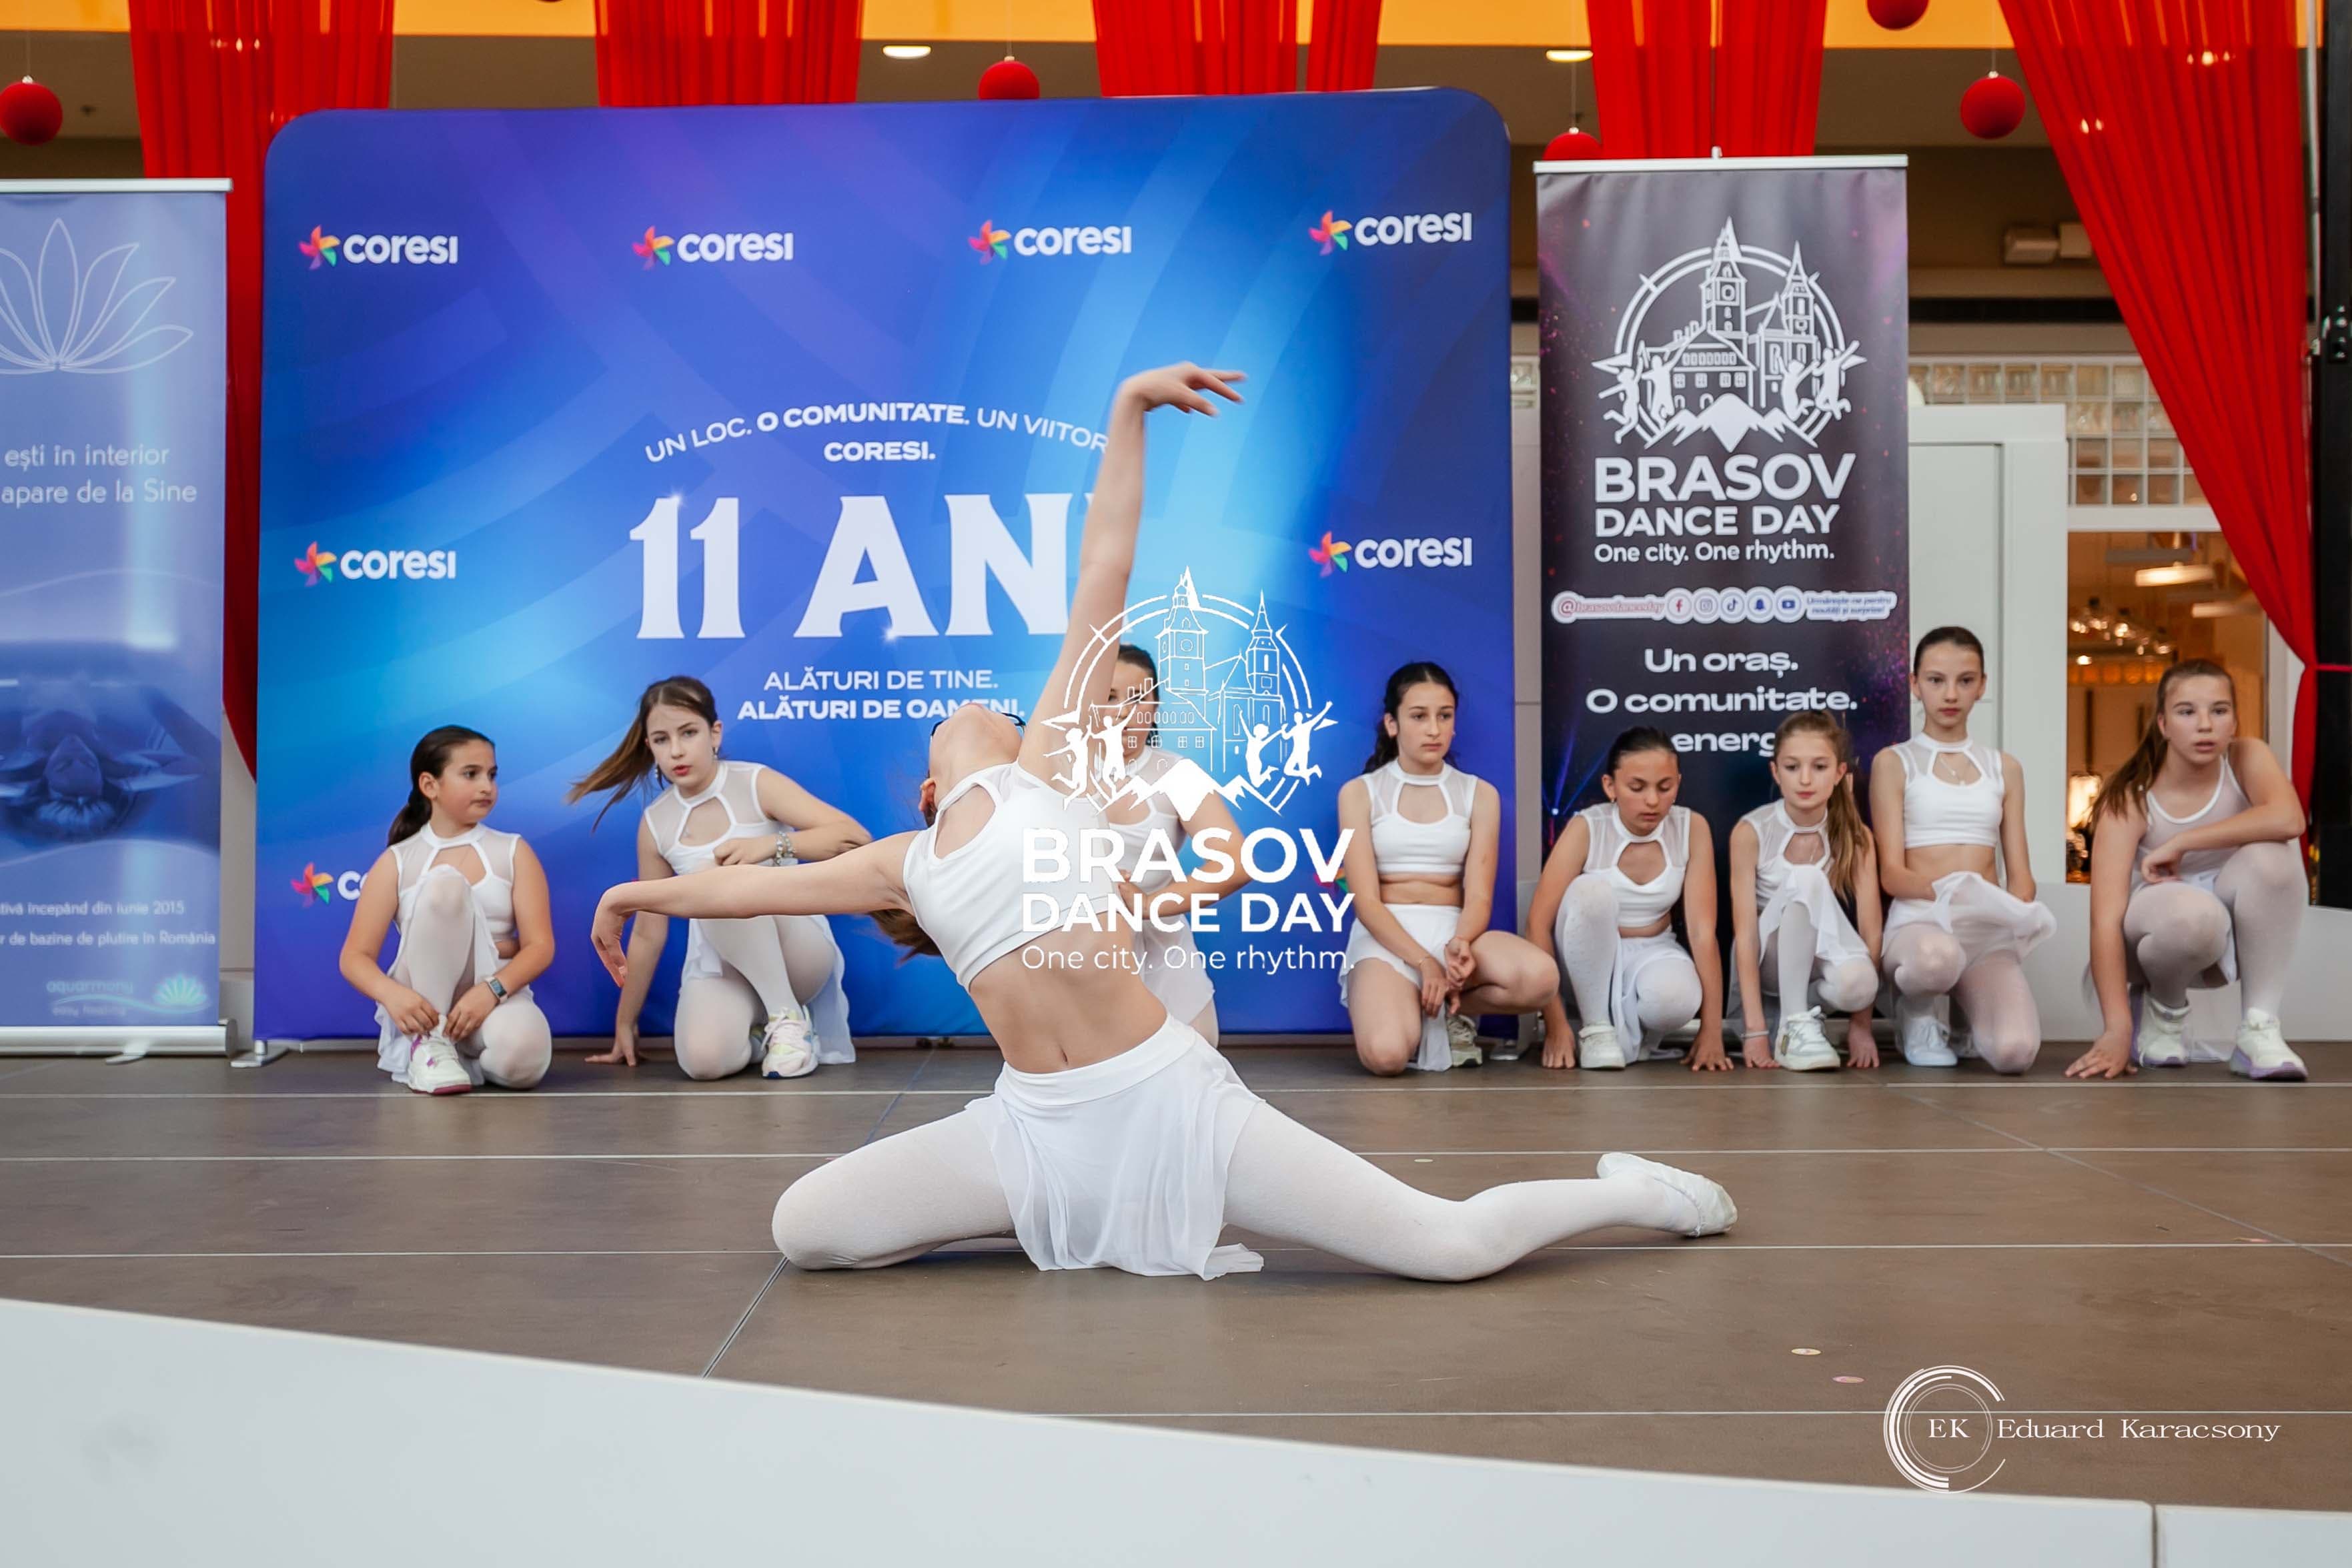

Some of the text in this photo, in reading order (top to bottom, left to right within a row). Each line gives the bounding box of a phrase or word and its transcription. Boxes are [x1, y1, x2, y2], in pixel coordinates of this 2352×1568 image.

[1013, 226, 1133, 256] coresi
[1354, 213, 1472, 246] coresi
[343, 234, 458, 264] coresi
[677, 233, 794, 262] coresi
[646, 433, 686, 462] UN
[692, 417, 752, 449] LOC.
[756, 412, 778, 432] O
[783, 402, 970, 428] COMUNITATE.
[977, 407, 1018, 432] UN
[5, 444, 45, 472] ești
[85, 444, 169, 466] interior
[824, 441, 936, 462] CORESI.
[1, 477, 197, 509] apare de la Sine
[1595, 453, 1856, 503] BRASOV
[1595, 504, 1840, 538] DANCE DAY
[340, 550, 456, 580] coresi
[629, 493, 1132, 639] 11 AN
[1354, 537, 1472, 568] coresi
[1594, 538, 1835, 566] One city. One rhythm.
[1645, 648, 1799, 678] Un oraș.
[763, 666, 999, 691] ALĂTURI DE TINE.
[737, 695, 856, 720] ALĂTURI
[862, 700, 901, 719] DE
[1586, 686, 1858, 714] O comunitate.
[92, 900, 113, 916] din
[117, 901, 149, 916] iunie
[153, 901, 185, 916] 2015
[9, 931, 25, 946] de
[30, 931, 73, 946] bazine
[77, 931, 94, 946] de
[98, 931, 139, 948] plutire
[159, 930, 216, 946] România
